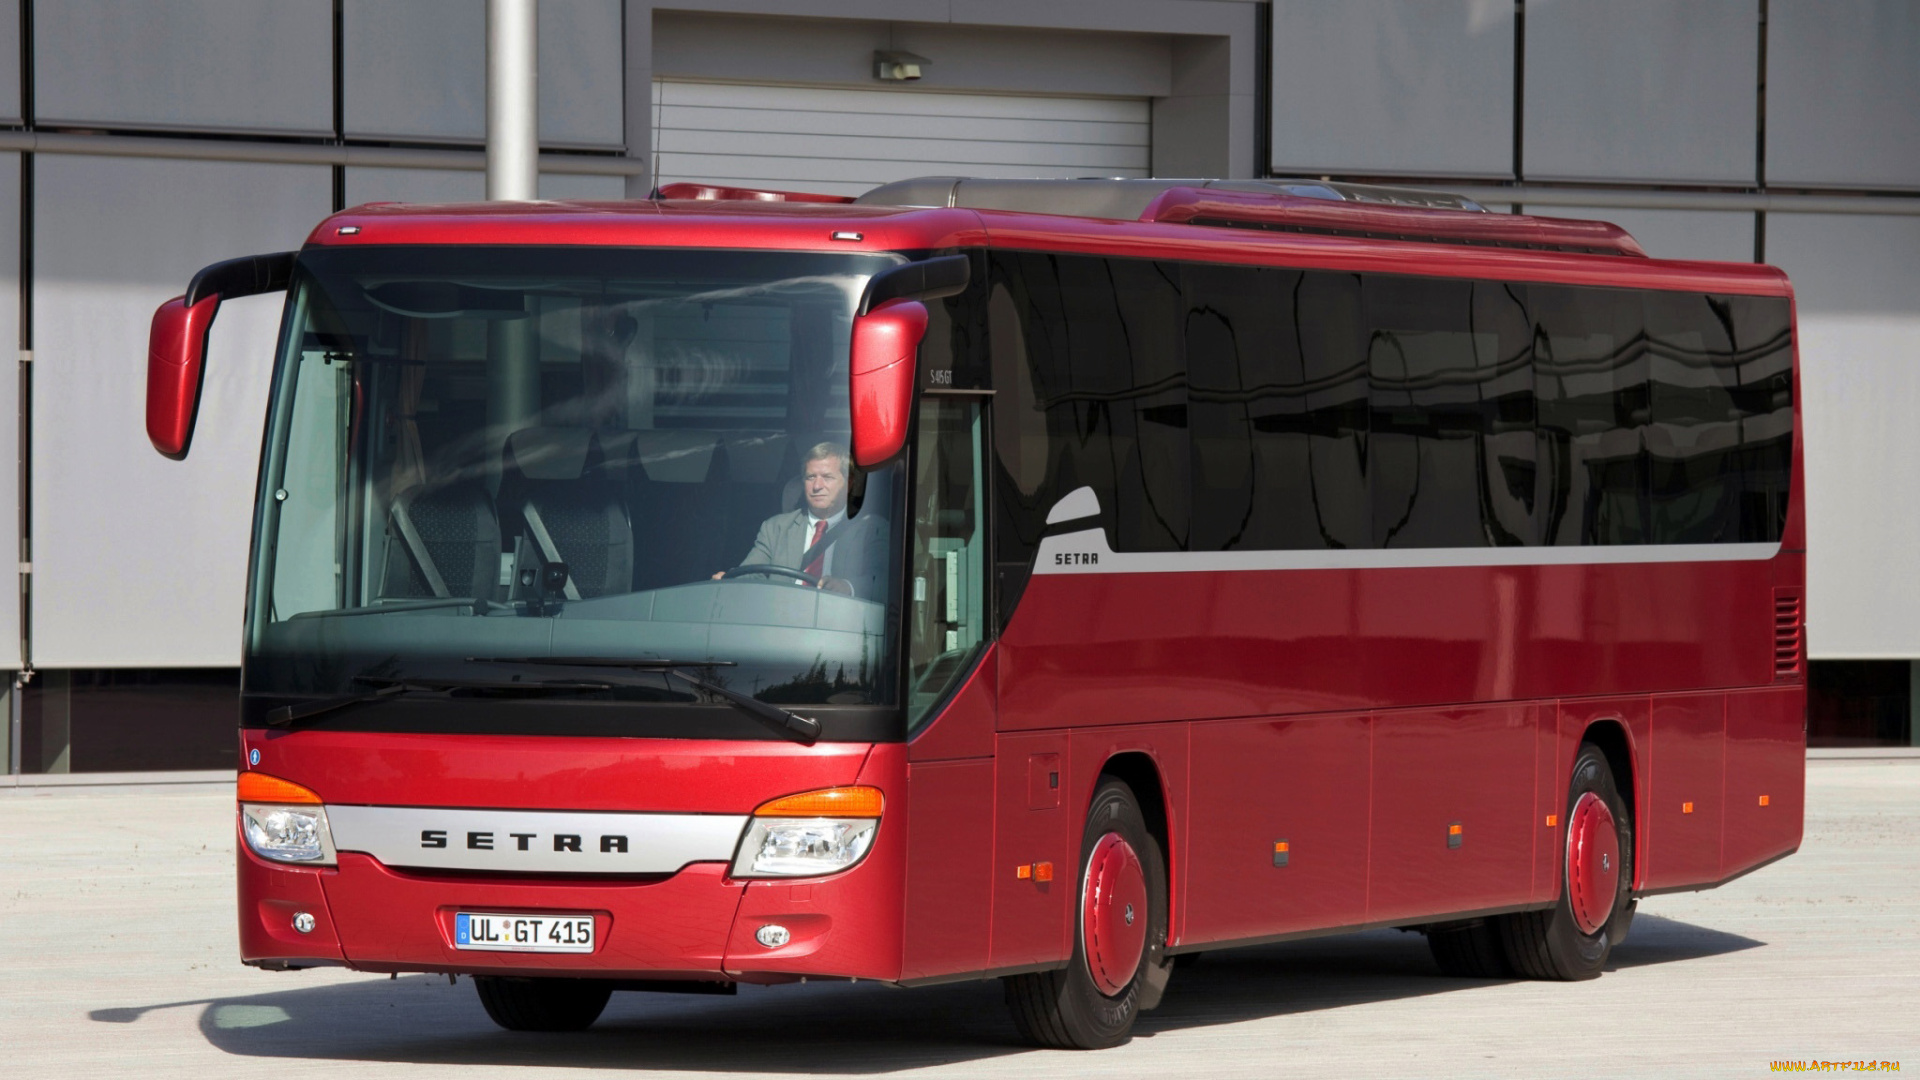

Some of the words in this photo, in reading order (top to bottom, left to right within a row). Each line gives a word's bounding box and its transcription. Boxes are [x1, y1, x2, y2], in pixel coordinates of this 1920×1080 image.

[1055, 553, 1098, 565] SETRA
[421, 830, 628, 853] SETRA
[471, 919, 499, 941] UL
[515, 920, 543, 943] GT
[549, 921, 591, 944] 415
